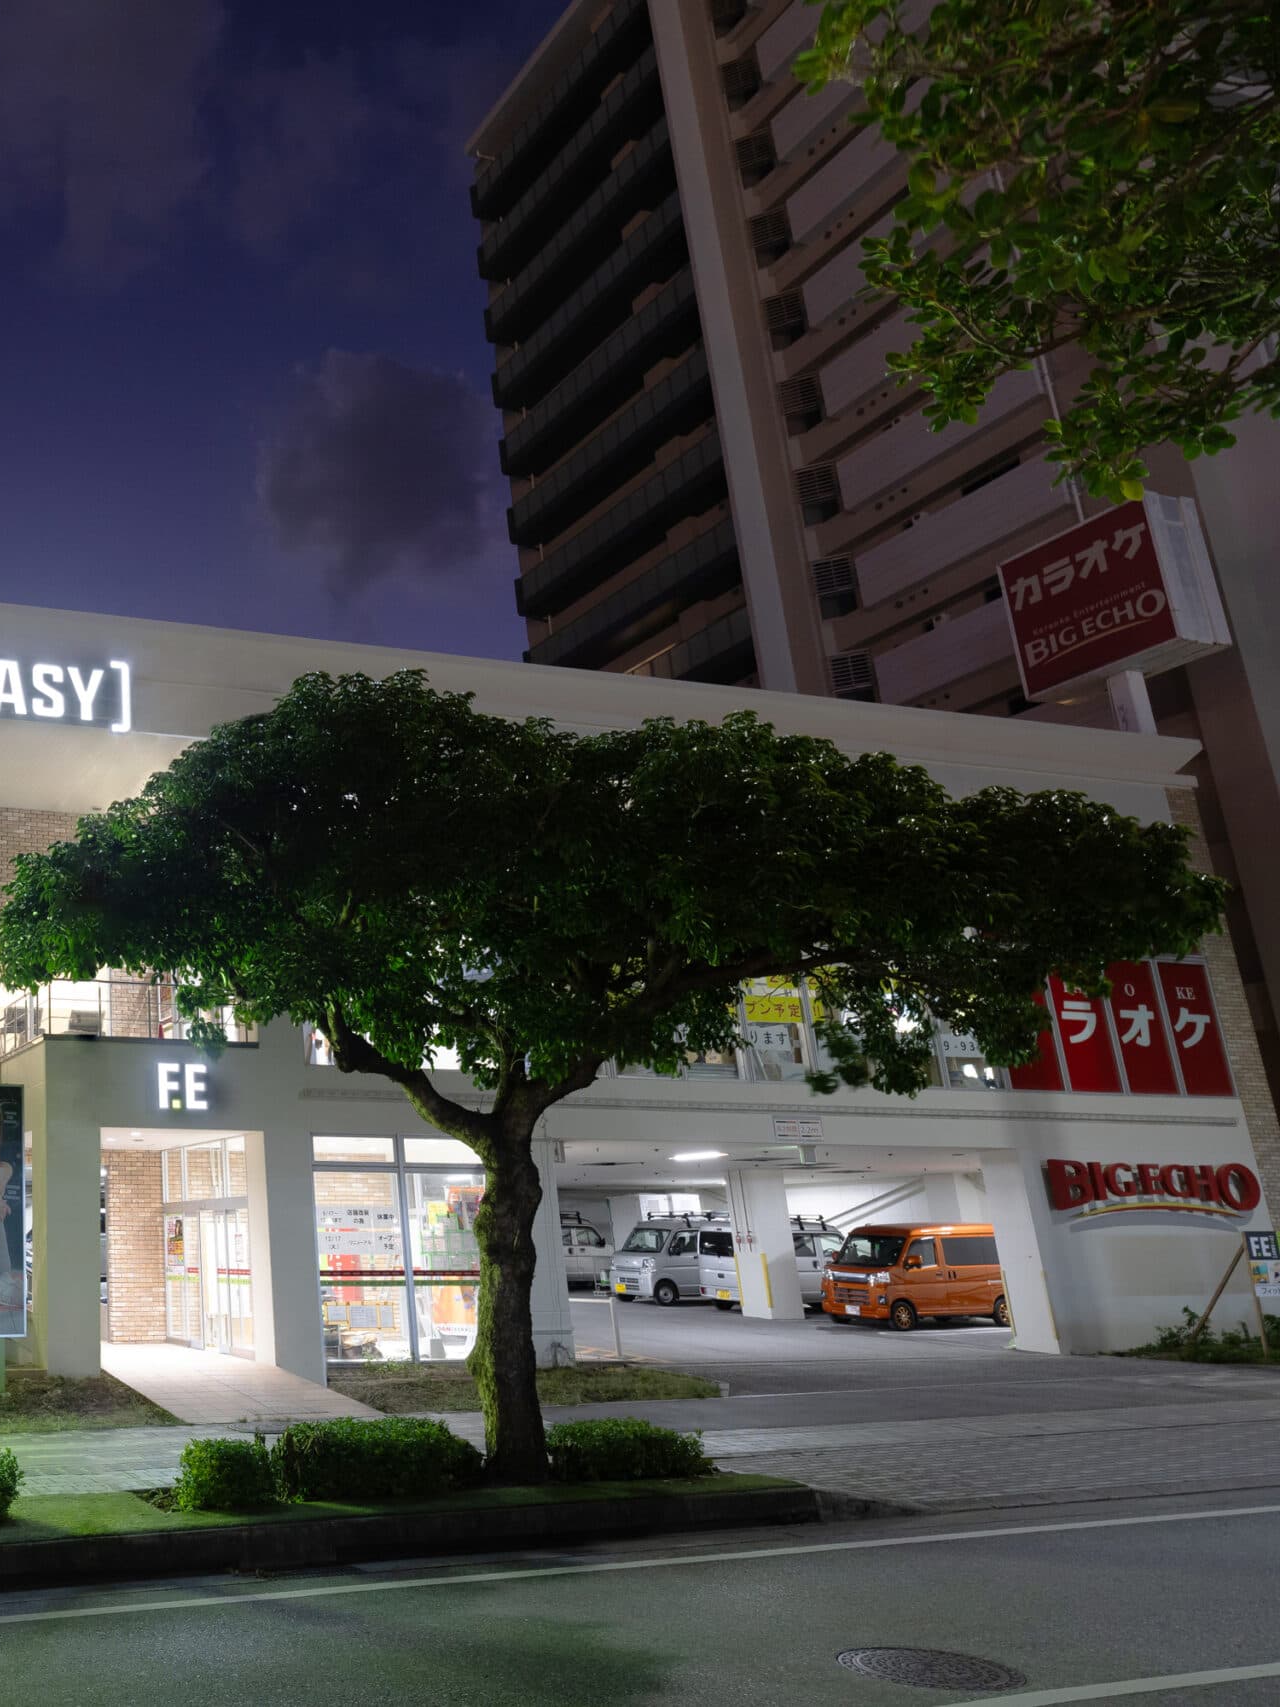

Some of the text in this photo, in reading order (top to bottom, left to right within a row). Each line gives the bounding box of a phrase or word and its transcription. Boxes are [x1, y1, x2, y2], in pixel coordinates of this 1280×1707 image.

[1010, 522, 1146, 611] カラオケ
[1024, 588, 1166, 668] BIG ECHO
[1124, 983, 1196, 1000] O KE
[751, 1031, 787, 1045] ります
[1061, 1000, 1211, 1049] ラオケ
